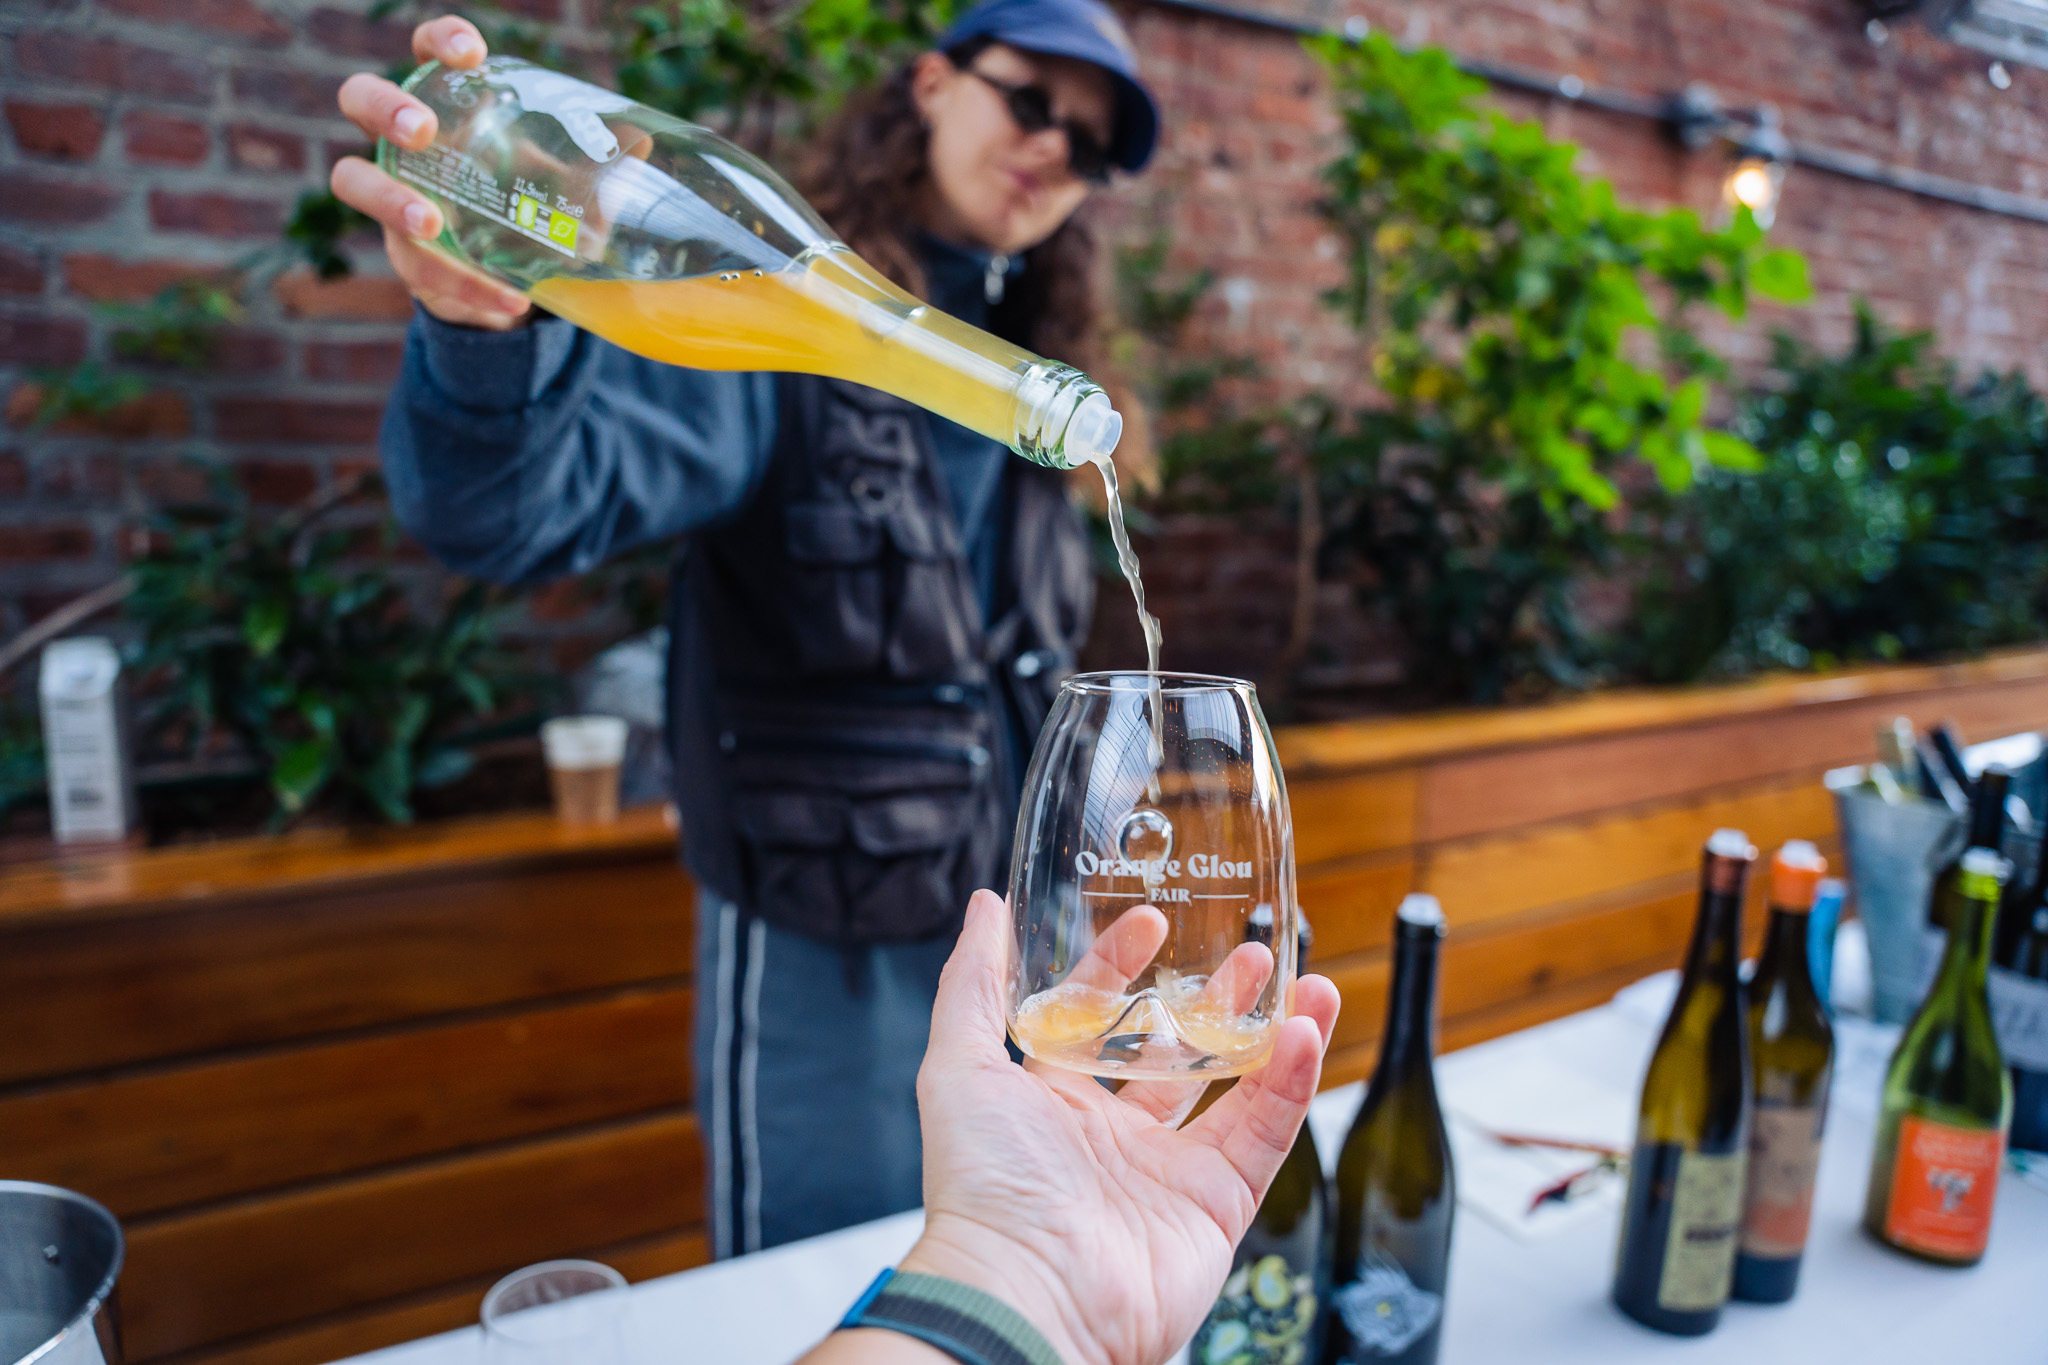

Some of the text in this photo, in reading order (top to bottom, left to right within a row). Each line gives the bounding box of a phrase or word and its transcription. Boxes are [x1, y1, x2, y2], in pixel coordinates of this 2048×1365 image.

[1075, 851, 1252, 885] Orange Glou
[1150, 888, 1192, 903] FAIR
